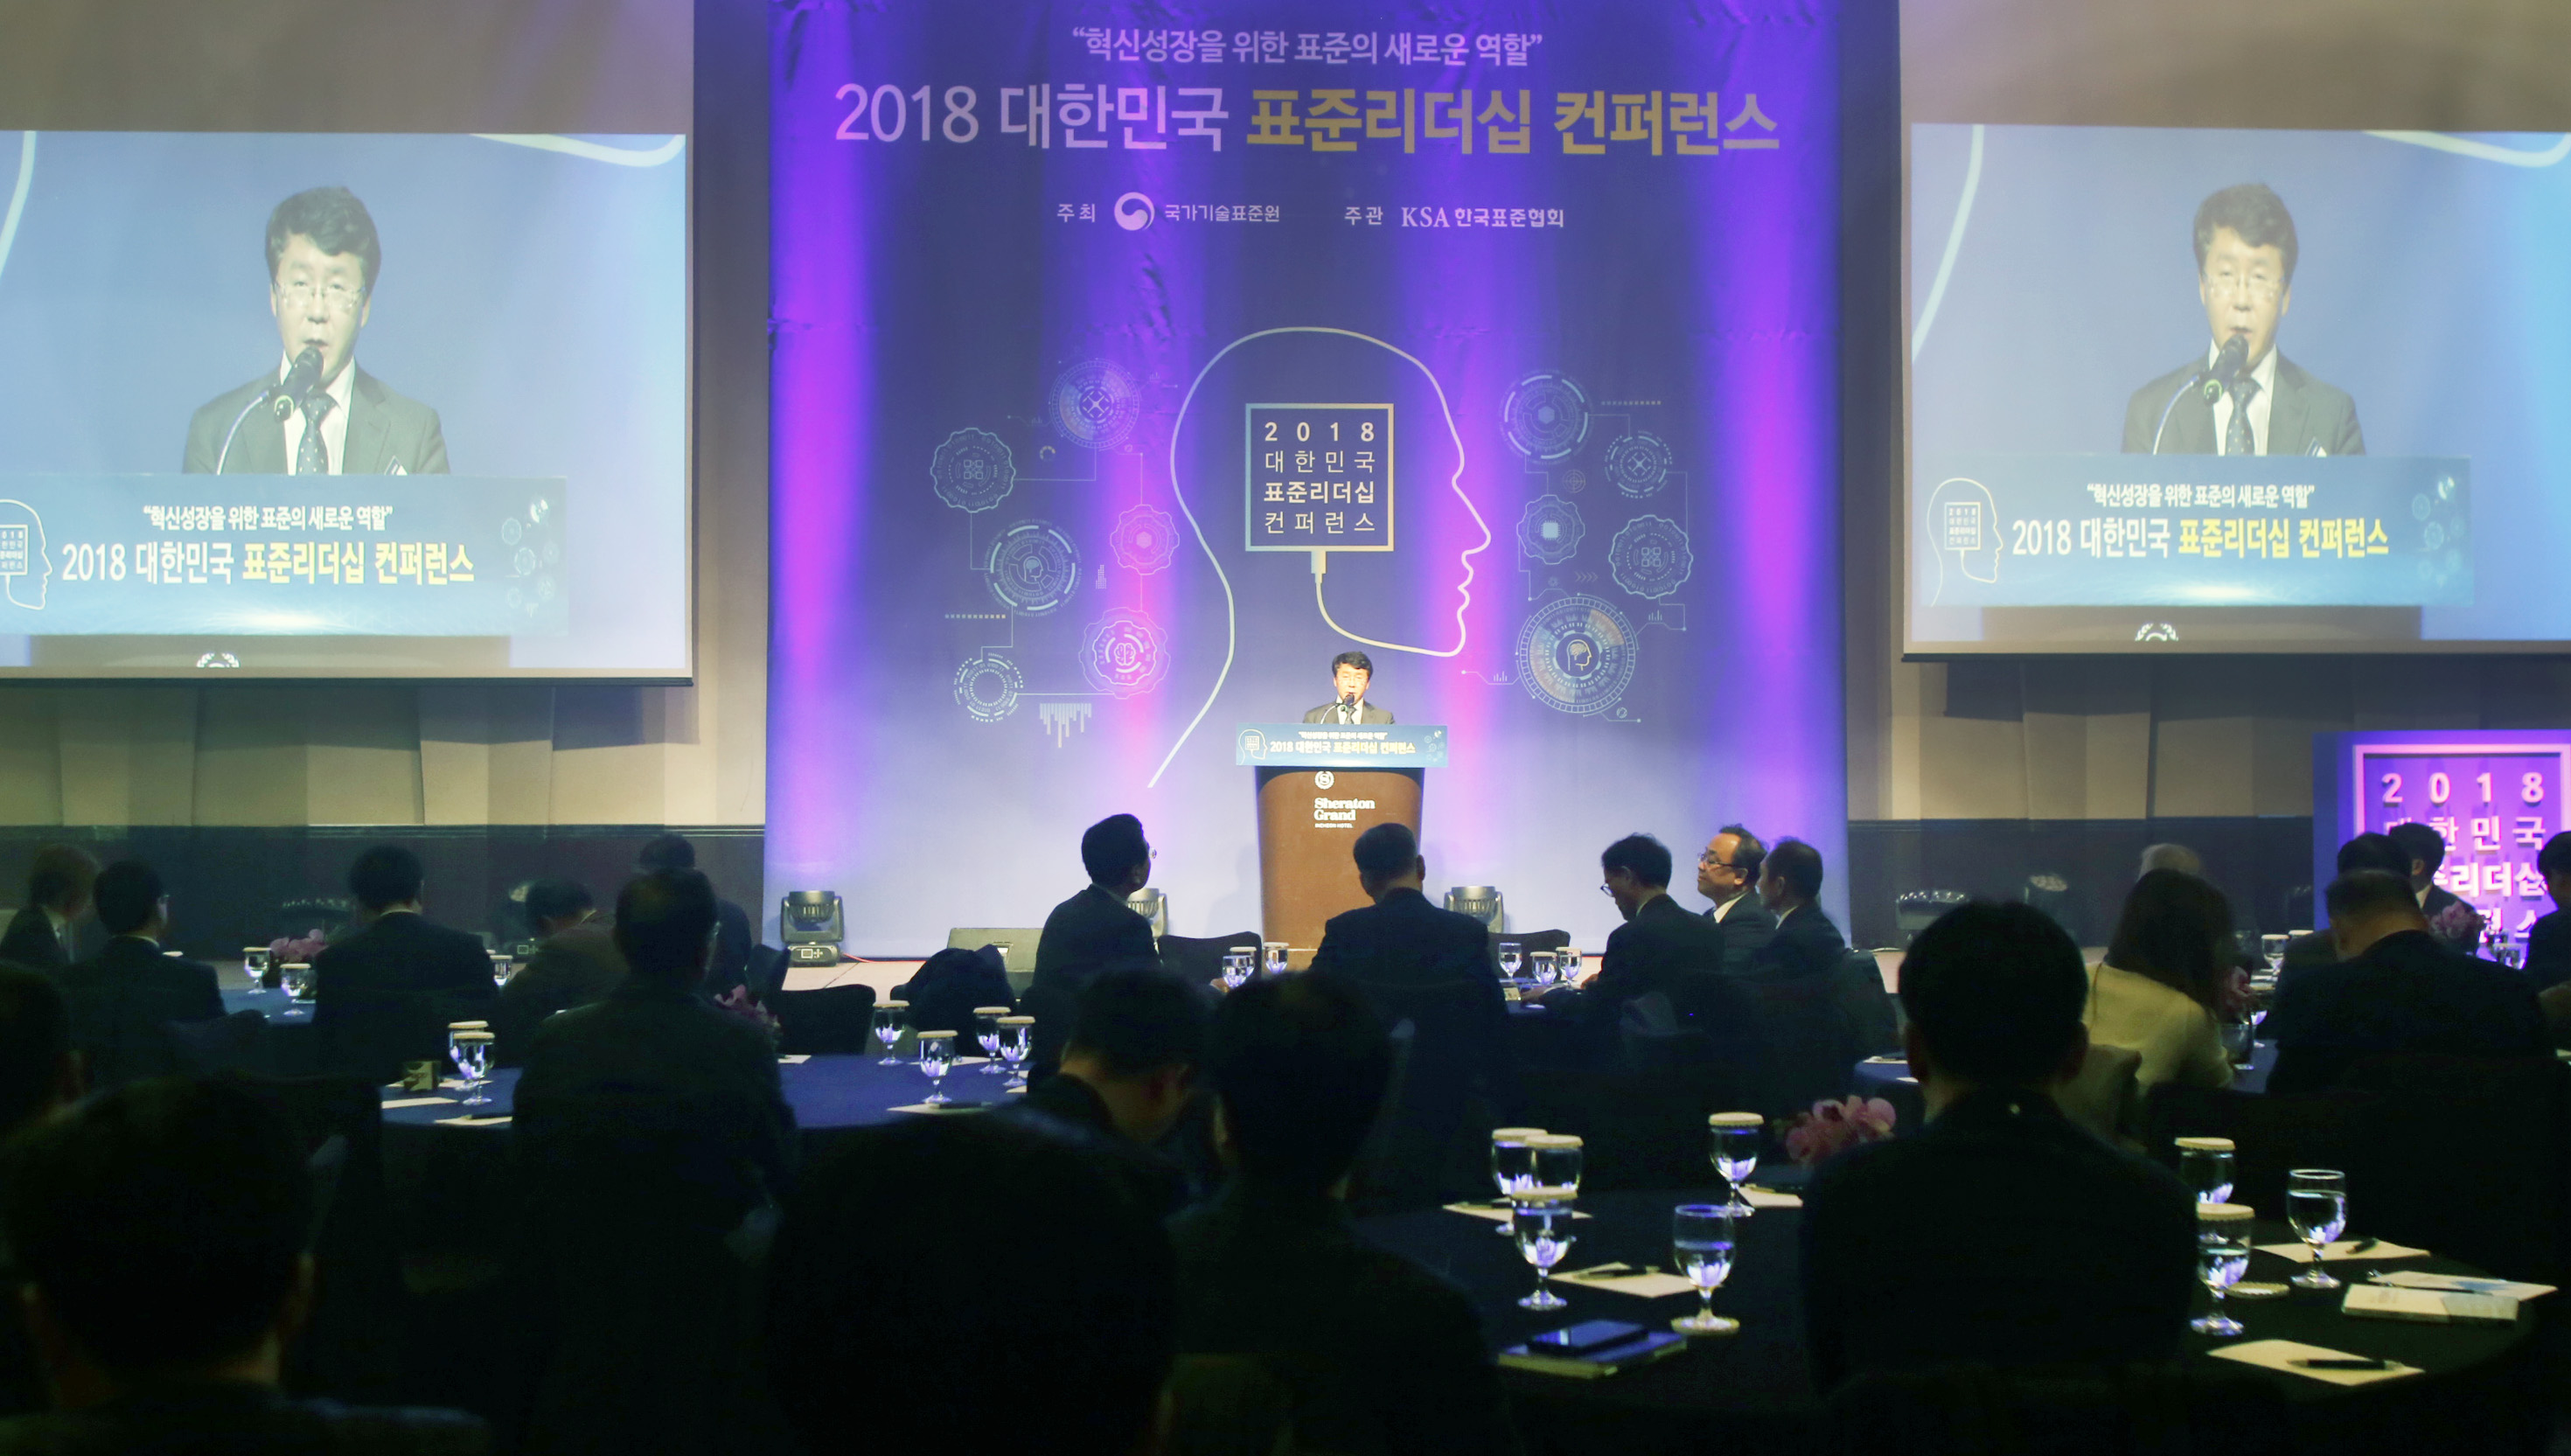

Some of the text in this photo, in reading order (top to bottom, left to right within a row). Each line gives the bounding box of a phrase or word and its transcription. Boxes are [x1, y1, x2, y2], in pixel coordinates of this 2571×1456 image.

[1072, 26, 1543, 66] “혁신성장을 위한 표준의 새로운 역할”
[835, 83, 1780, 156] 2018 대한민국 표준리더십 컨퍼런스
[1165, 204, 1280, 222] 국가기술표준원
[1401, 206, 1450, 227] KSA
[1454, 207, 1564, 227] 한국표준협회
[1264, 481, 1374, 504] 표준리더십
[2087, 483, 2315, 509] “혁신성장을 위한 표준의 새로운 역할”
[143, 505, 394, 531] “혁신성장을 위한 표준의 새로운 역할”
[2012, 517, 2389, 559] 2018 대한민국 표준리더십 컨퍼런스
[62, 541, 474, 585] 2018 대한민국 표준리더십 컨퍼런스
[1270, 741, 1293, 753] 2018
[1313, 809, 1356, 821] Grand
[1314, 798, 1376, 809] Sheraton
[2384, 817, 2546, 850] 한민국
